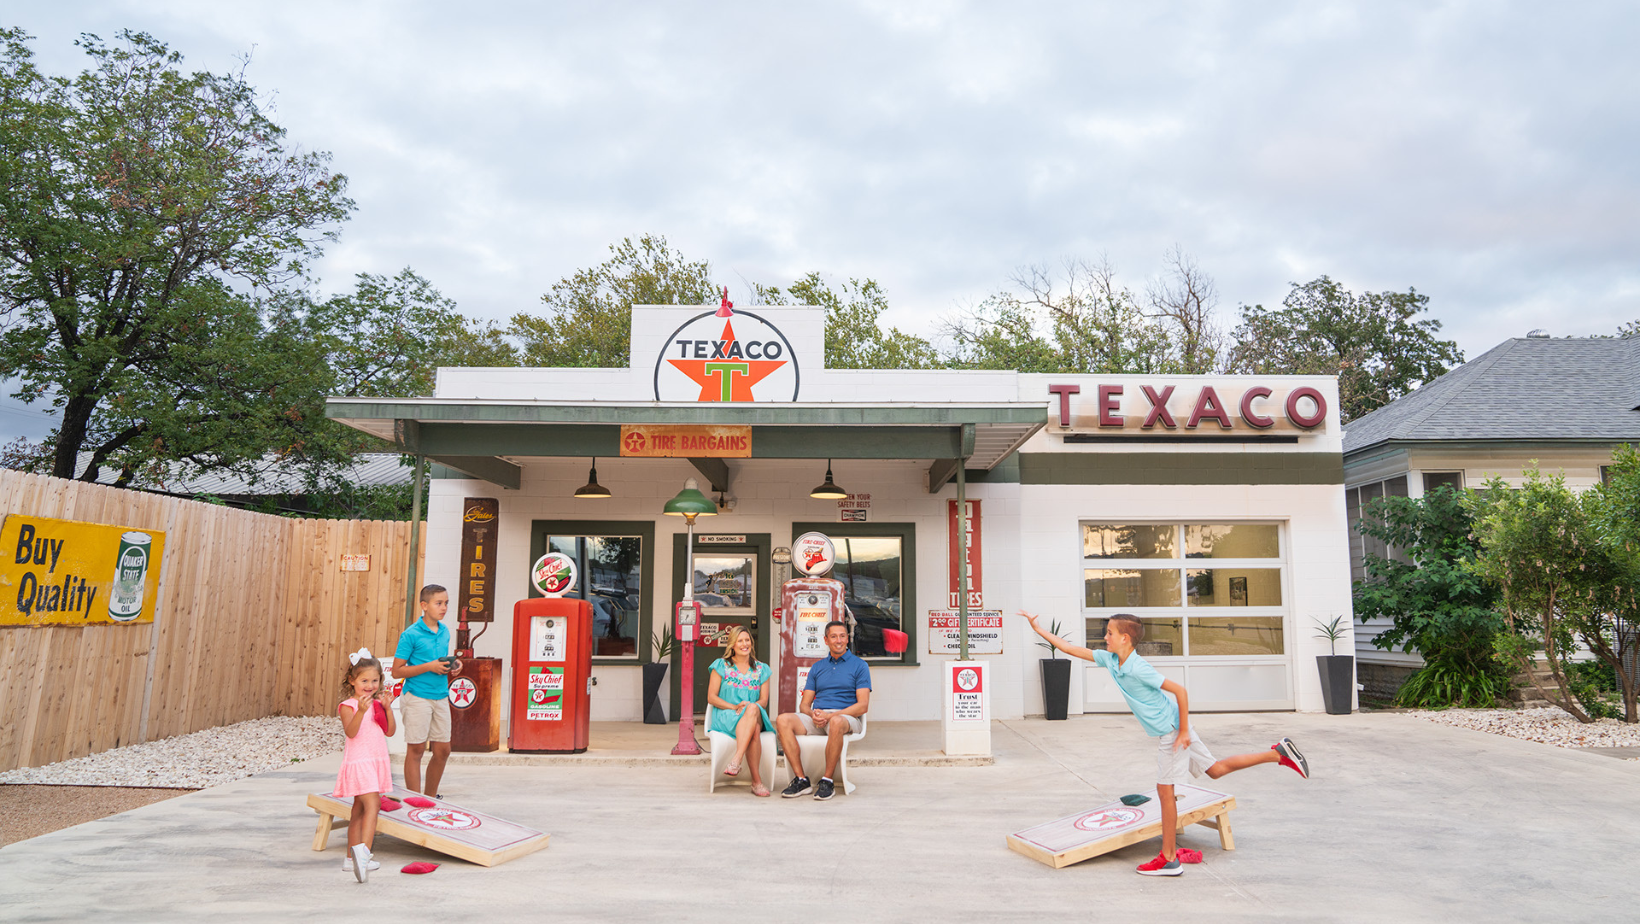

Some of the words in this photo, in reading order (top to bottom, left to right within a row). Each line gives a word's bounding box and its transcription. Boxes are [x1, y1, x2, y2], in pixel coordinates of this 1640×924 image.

[676, 340, 782, 360] TEXACO
[1049, 384, 1327, 429] TEXACO
[651, 436, 676, 450] TIRE
[681, 436, 747, 450] BARGAINS
[464, 507, 494, 522] Gates
[15, 524, 64, 573] Buy
[124, 555, 144, 567] QUAKER
[468, 528, 487, 612] TIRES
[539, 569, 549, 580] Sky
[549, 558, 563, 573] Chief
[123, 569, 140, 580] STATE
[16, 572, 97, 618] Quality
[530, 674, 543, 684] Sky
[544, 674, 563, 684] Chief
